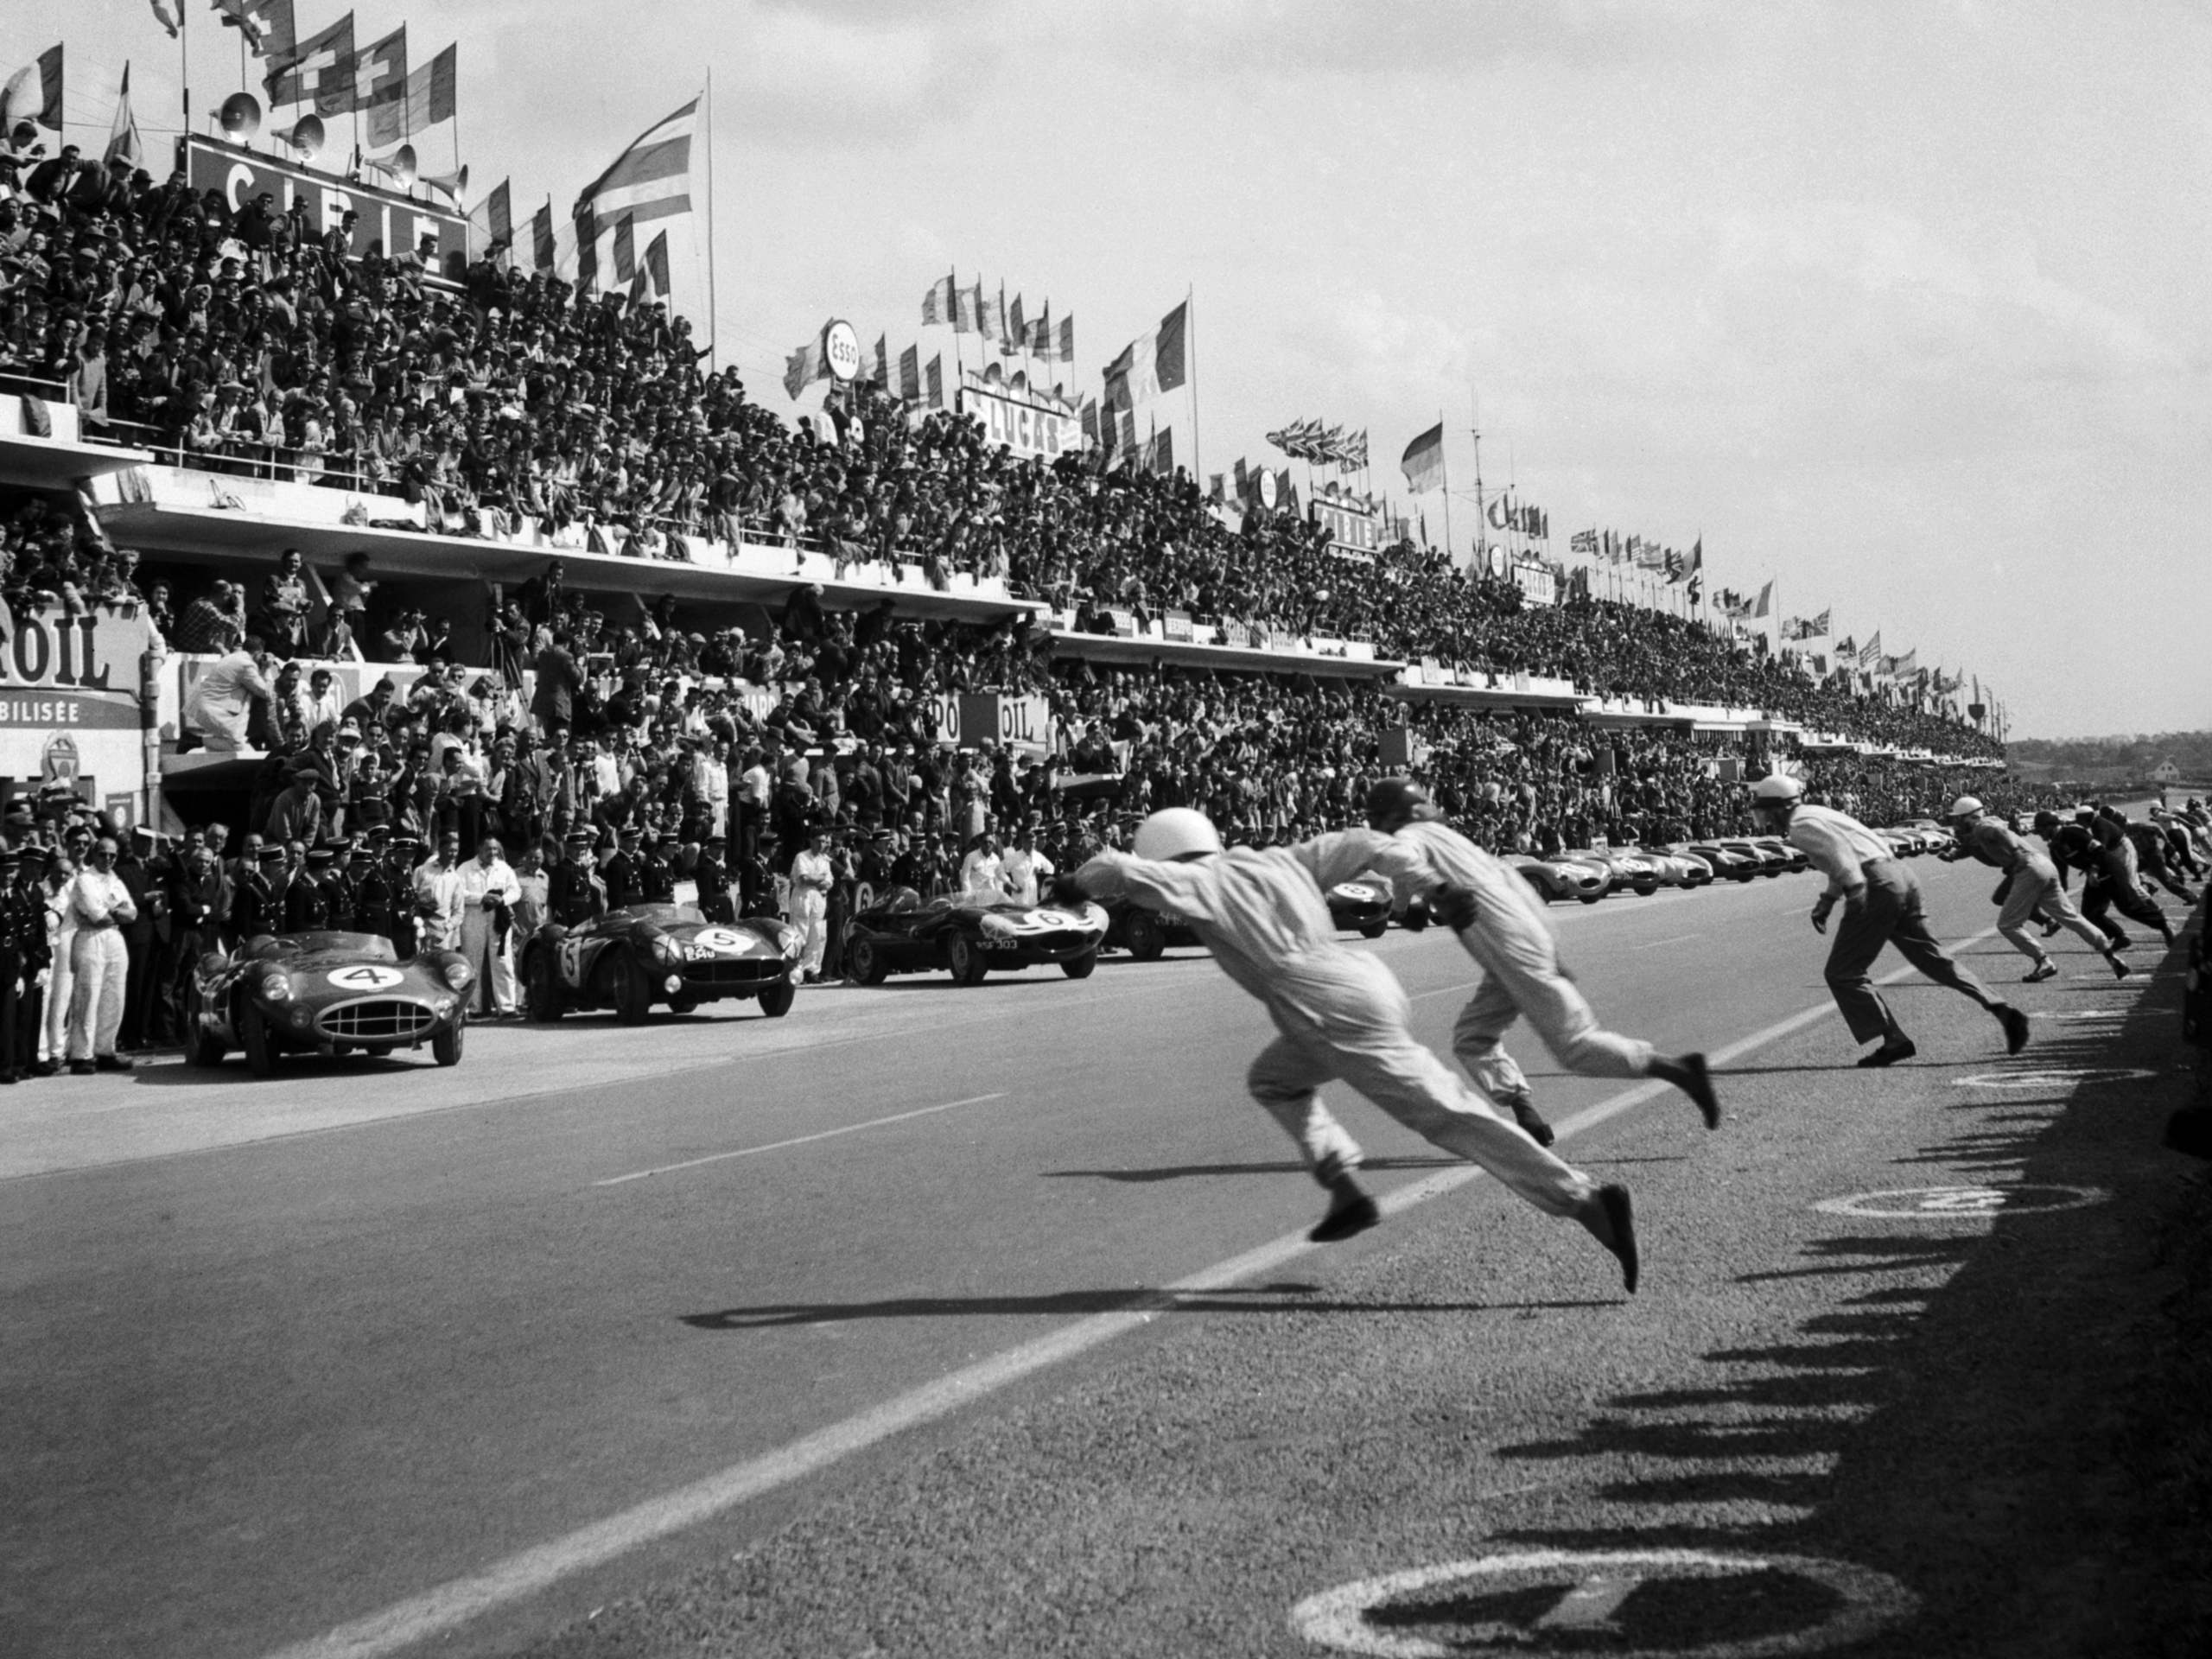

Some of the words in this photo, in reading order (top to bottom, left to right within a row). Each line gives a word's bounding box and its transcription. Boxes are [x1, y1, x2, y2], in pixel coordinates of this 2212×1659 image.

[991, 401, 1059, 455] LUCAS
[0, 616, 110, 689] OIL
[1037, 912, 1065, 925] 6
[714, 932, 736, 946] 5
[995, 939, 1018, 950] 303
[565, 942, 575, 977] 5
[342, 968, 388, 984] 4
